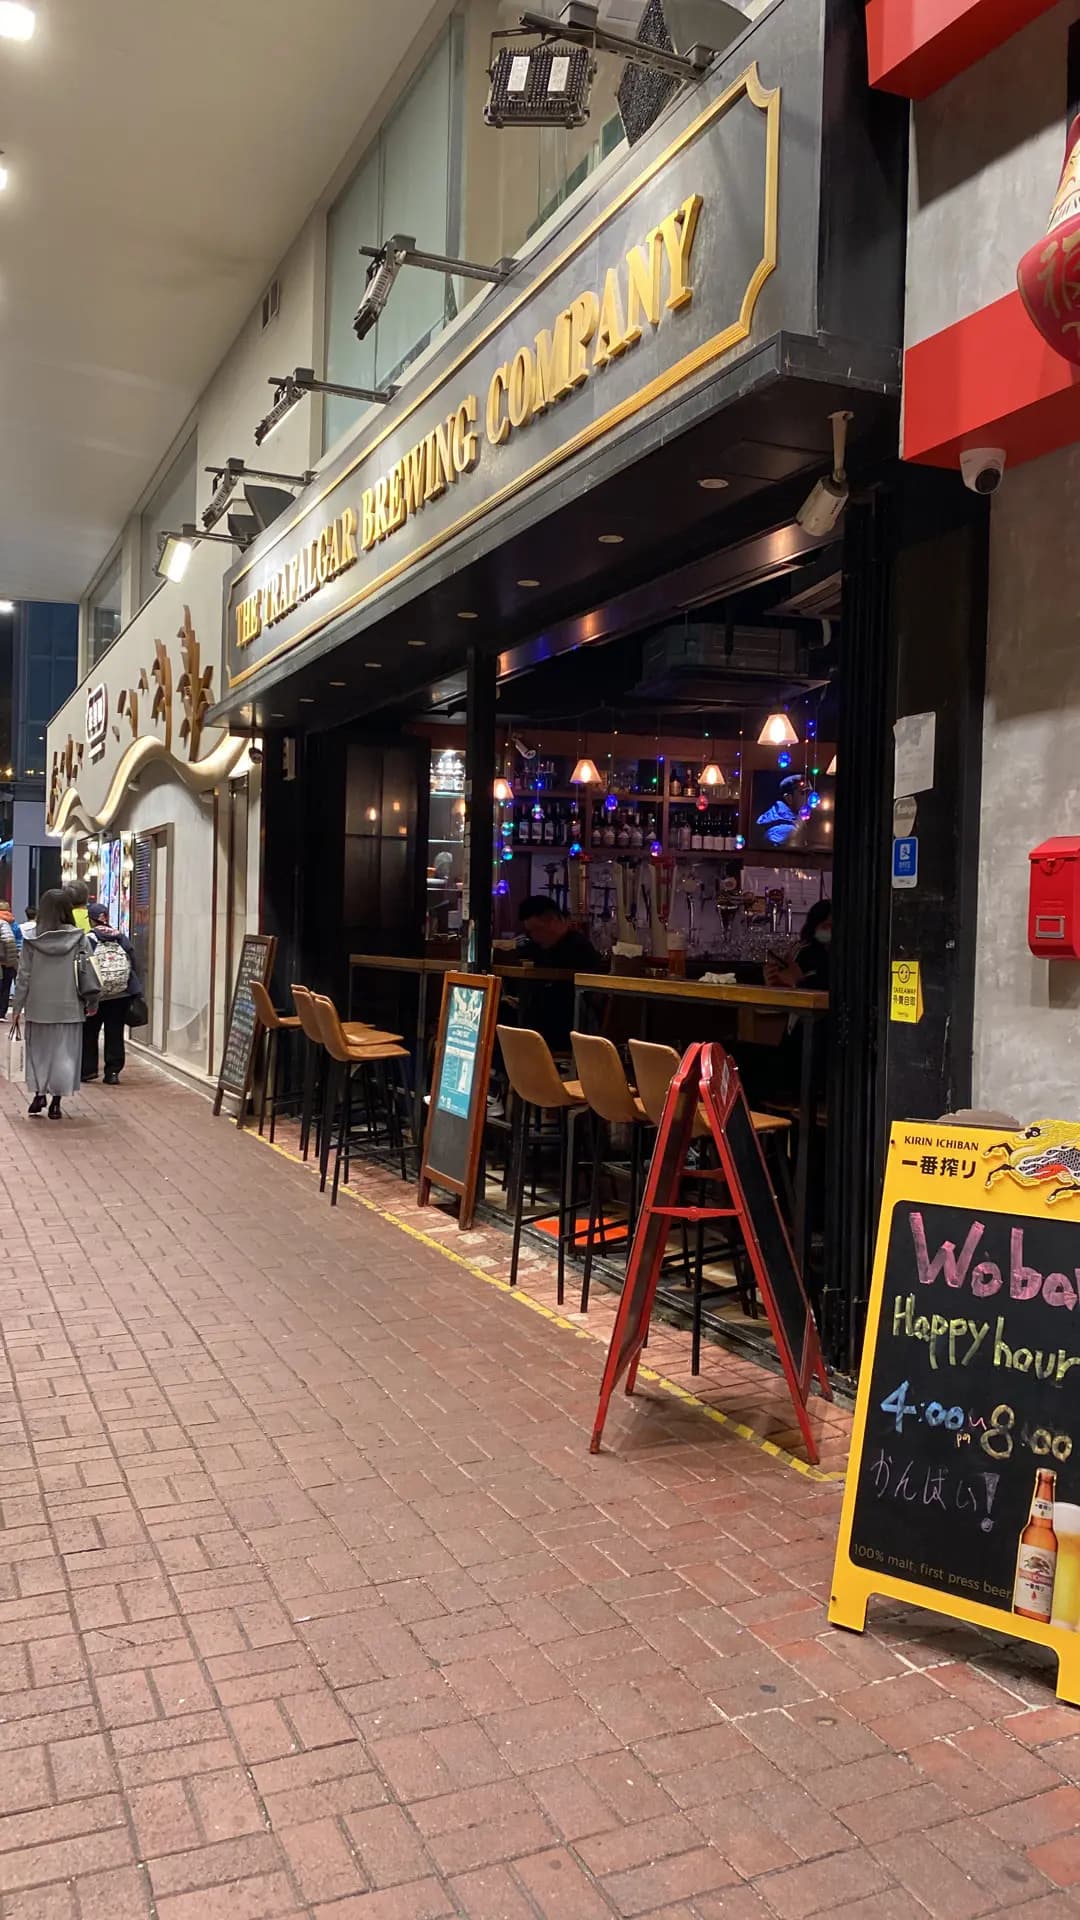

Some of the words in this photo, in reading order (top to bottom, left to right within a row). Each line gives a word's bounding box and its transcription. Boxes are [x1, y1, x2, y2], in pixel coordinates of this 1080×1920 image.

[236, 589, 262, 648] THE
[263, 508, 358, 627] TRAFALGAR
[361, 394, 479, 551] BREWING
[486, 193, 704, 444] COMPANY
[901, 1155, 976, 1179] 一番搾り
[904, 1136, 933, 1147] KIRIN
[936, 1138, 979, 1151] ICHIBAN
[909, 1211, 1080, 1312] Woba
[892, 1293, 990, 1370] Happy
[854, 1543, 885, 1562] 100%
[920, 1562, 944, 1581] first
[948, 1572, 980, 1591] press
